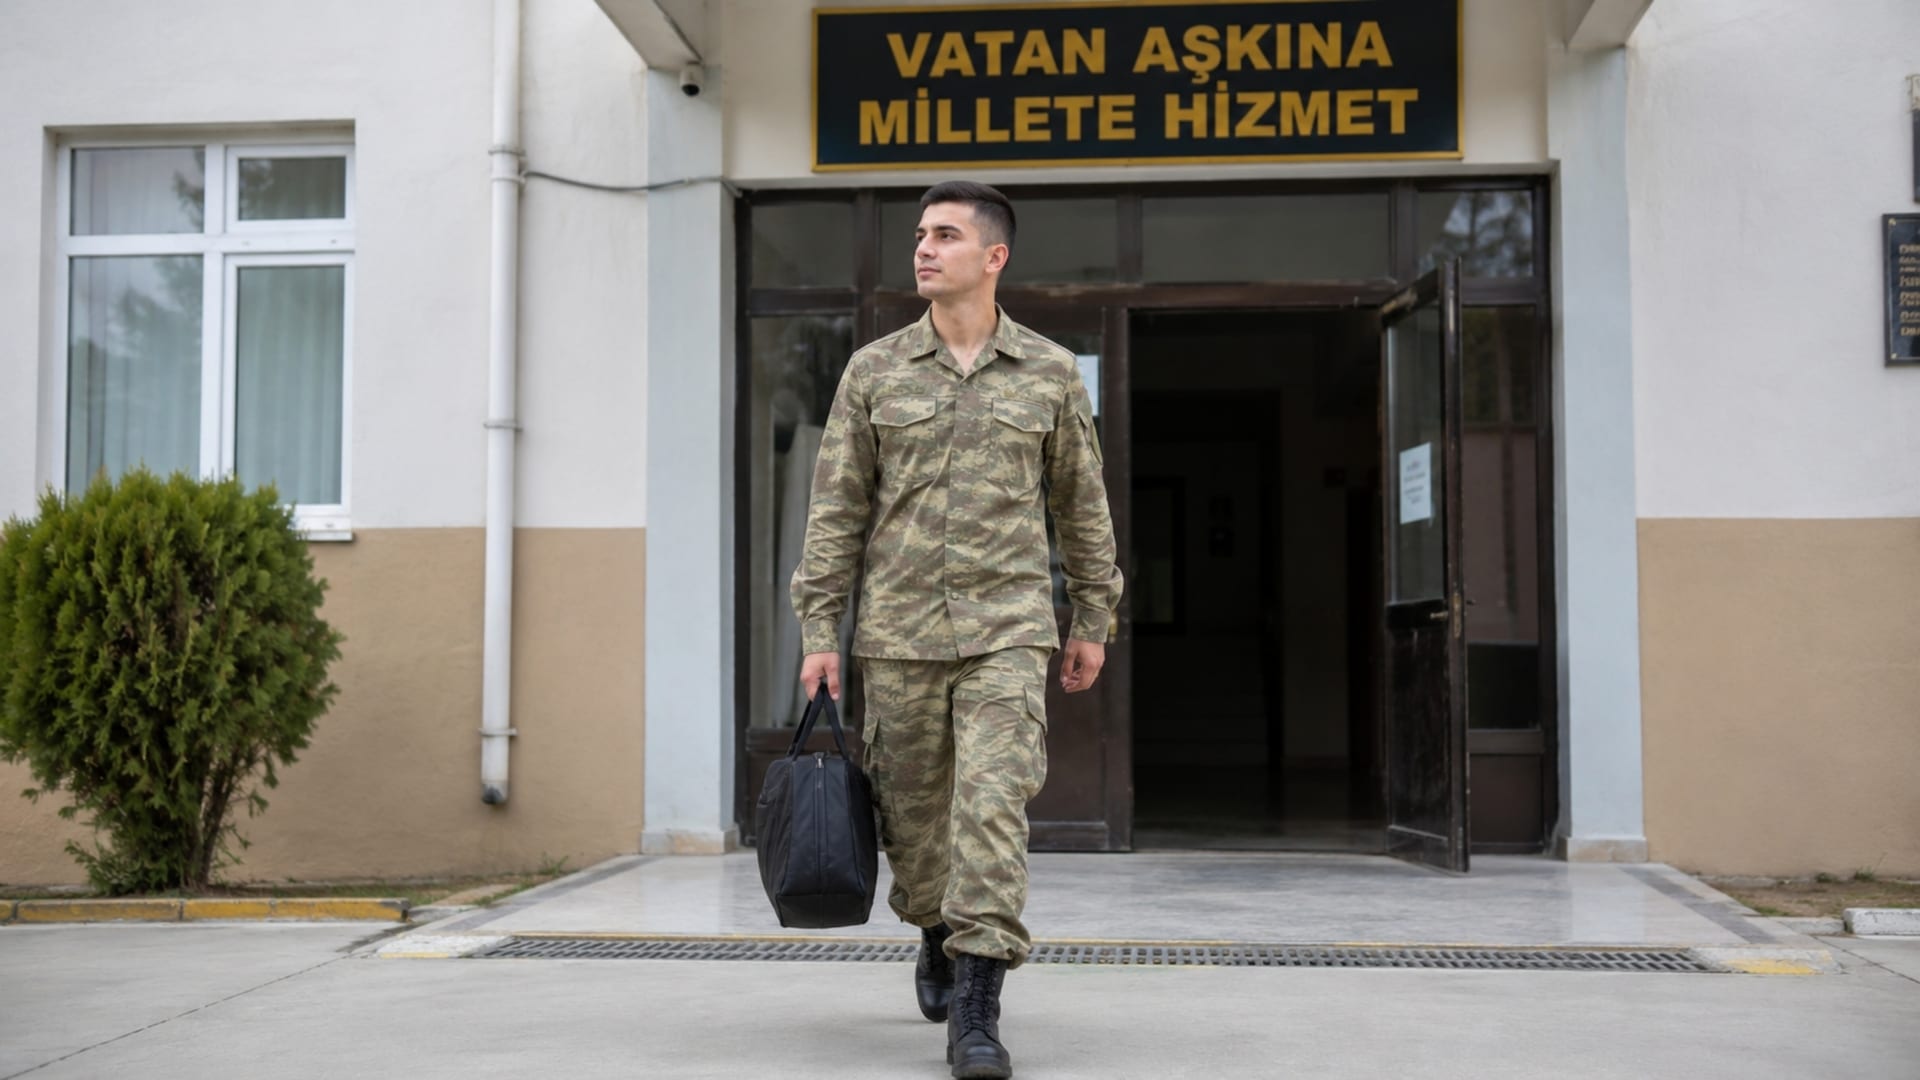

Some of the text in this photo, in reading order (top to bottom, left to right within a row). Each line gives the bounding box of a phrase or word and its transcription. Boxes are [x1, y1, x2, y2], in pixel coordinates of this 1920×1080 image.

[887, 22, 1393, 84] VATAN AŞKINA
[859, 81, 1419, 145] MİLLETE HİZMET
